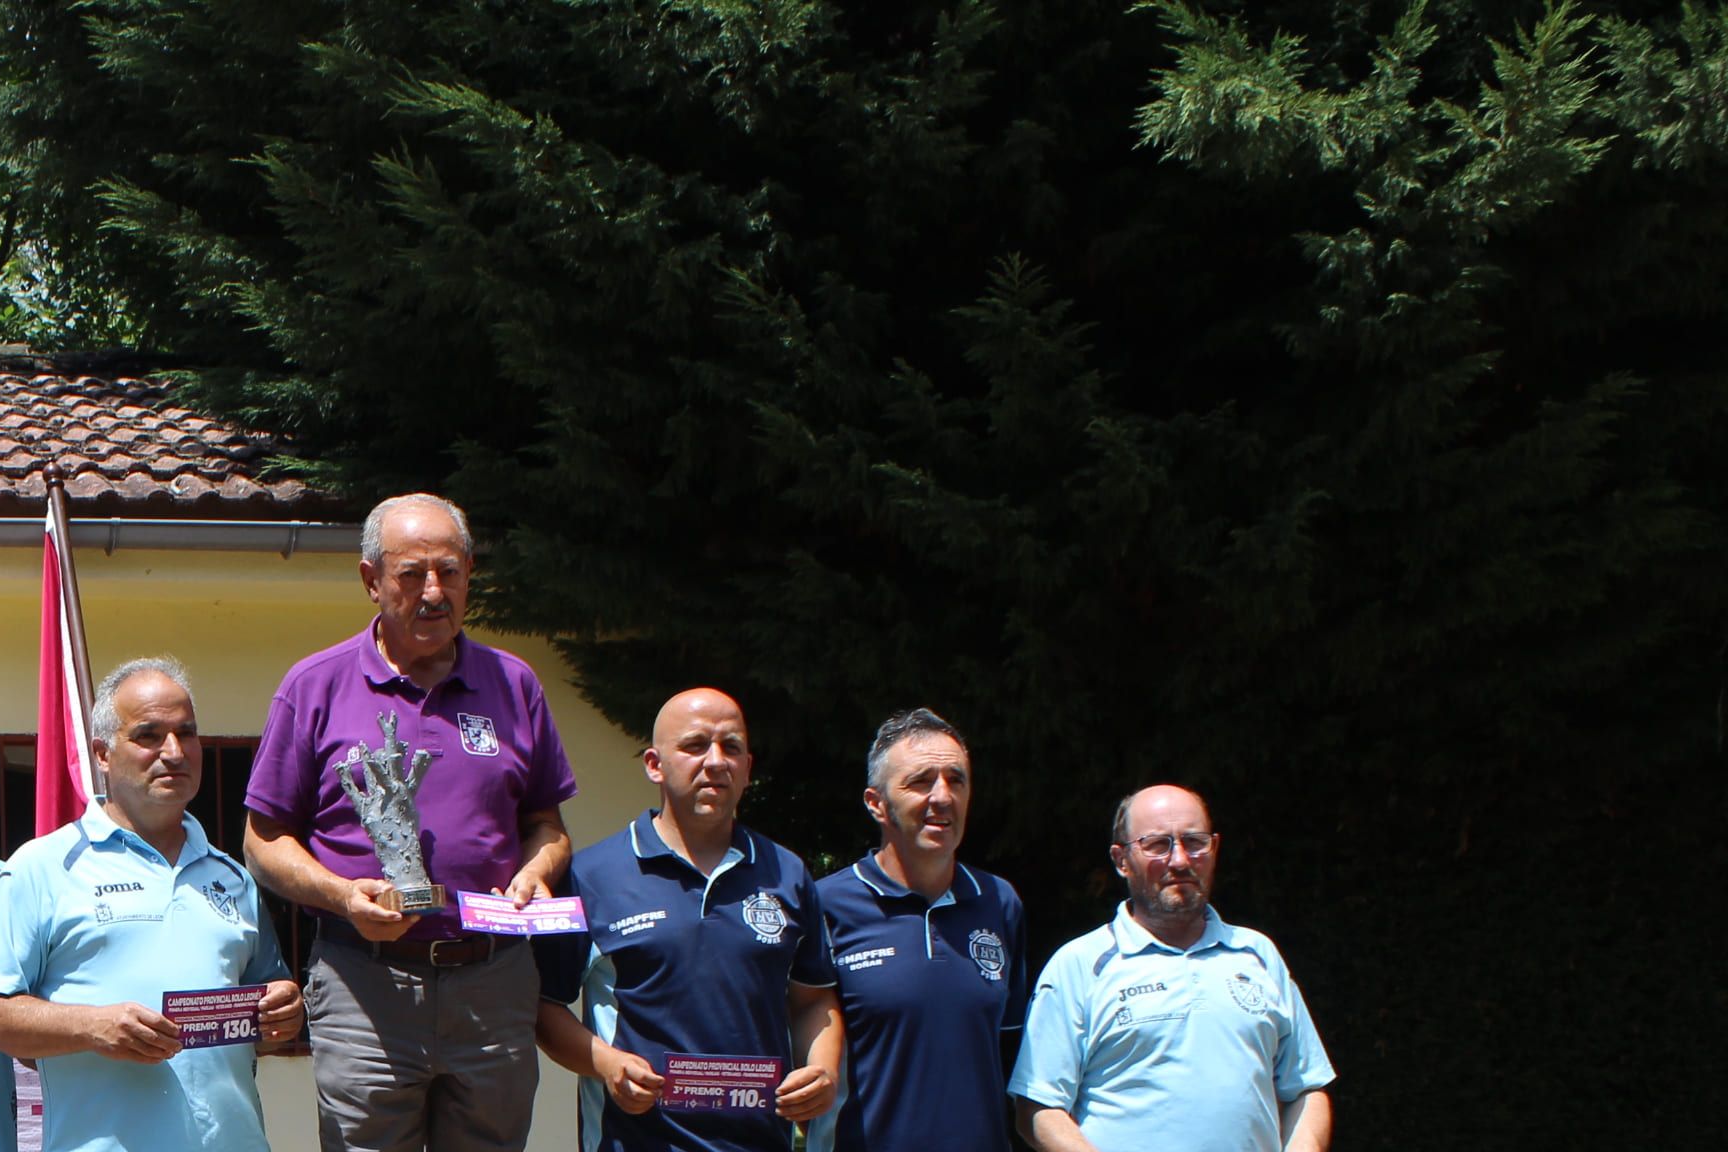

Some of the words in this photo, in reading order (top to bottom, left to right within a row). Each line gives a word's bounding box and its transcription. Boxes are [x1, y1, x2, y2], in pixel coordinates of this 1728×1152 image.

[615, 910, 667, 930] MAPFRE
[845, 947, 896, 965] MAPFRE
[669, 1060, 708, 1070] CAMPEONATO
[684, 1086, 725, 1096] PREMIO:
